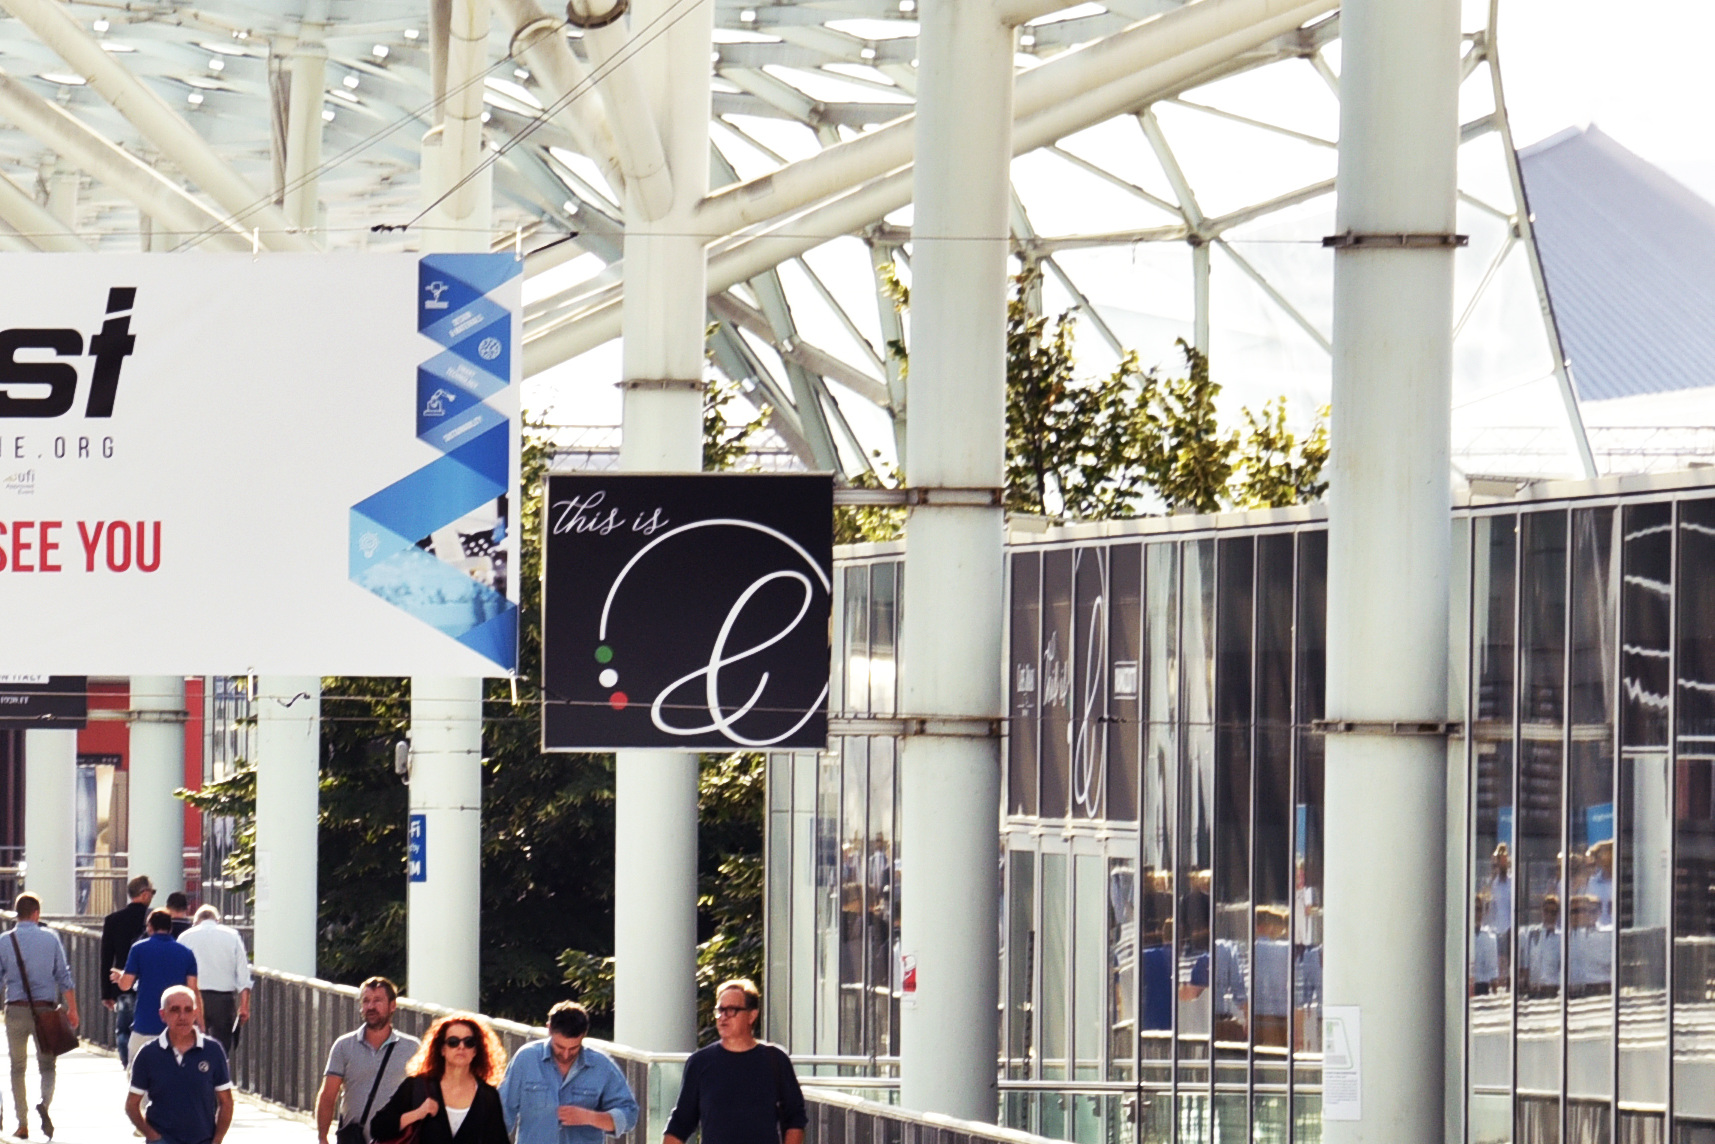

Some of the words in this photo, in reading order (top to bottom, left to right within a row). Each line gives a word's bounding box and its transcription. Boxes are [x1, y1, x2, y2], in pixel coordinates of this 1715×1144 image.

[552, 490, 626, 535] this
[632, 507, 670, 535] is
[76, 520, 162, 573] YOU
